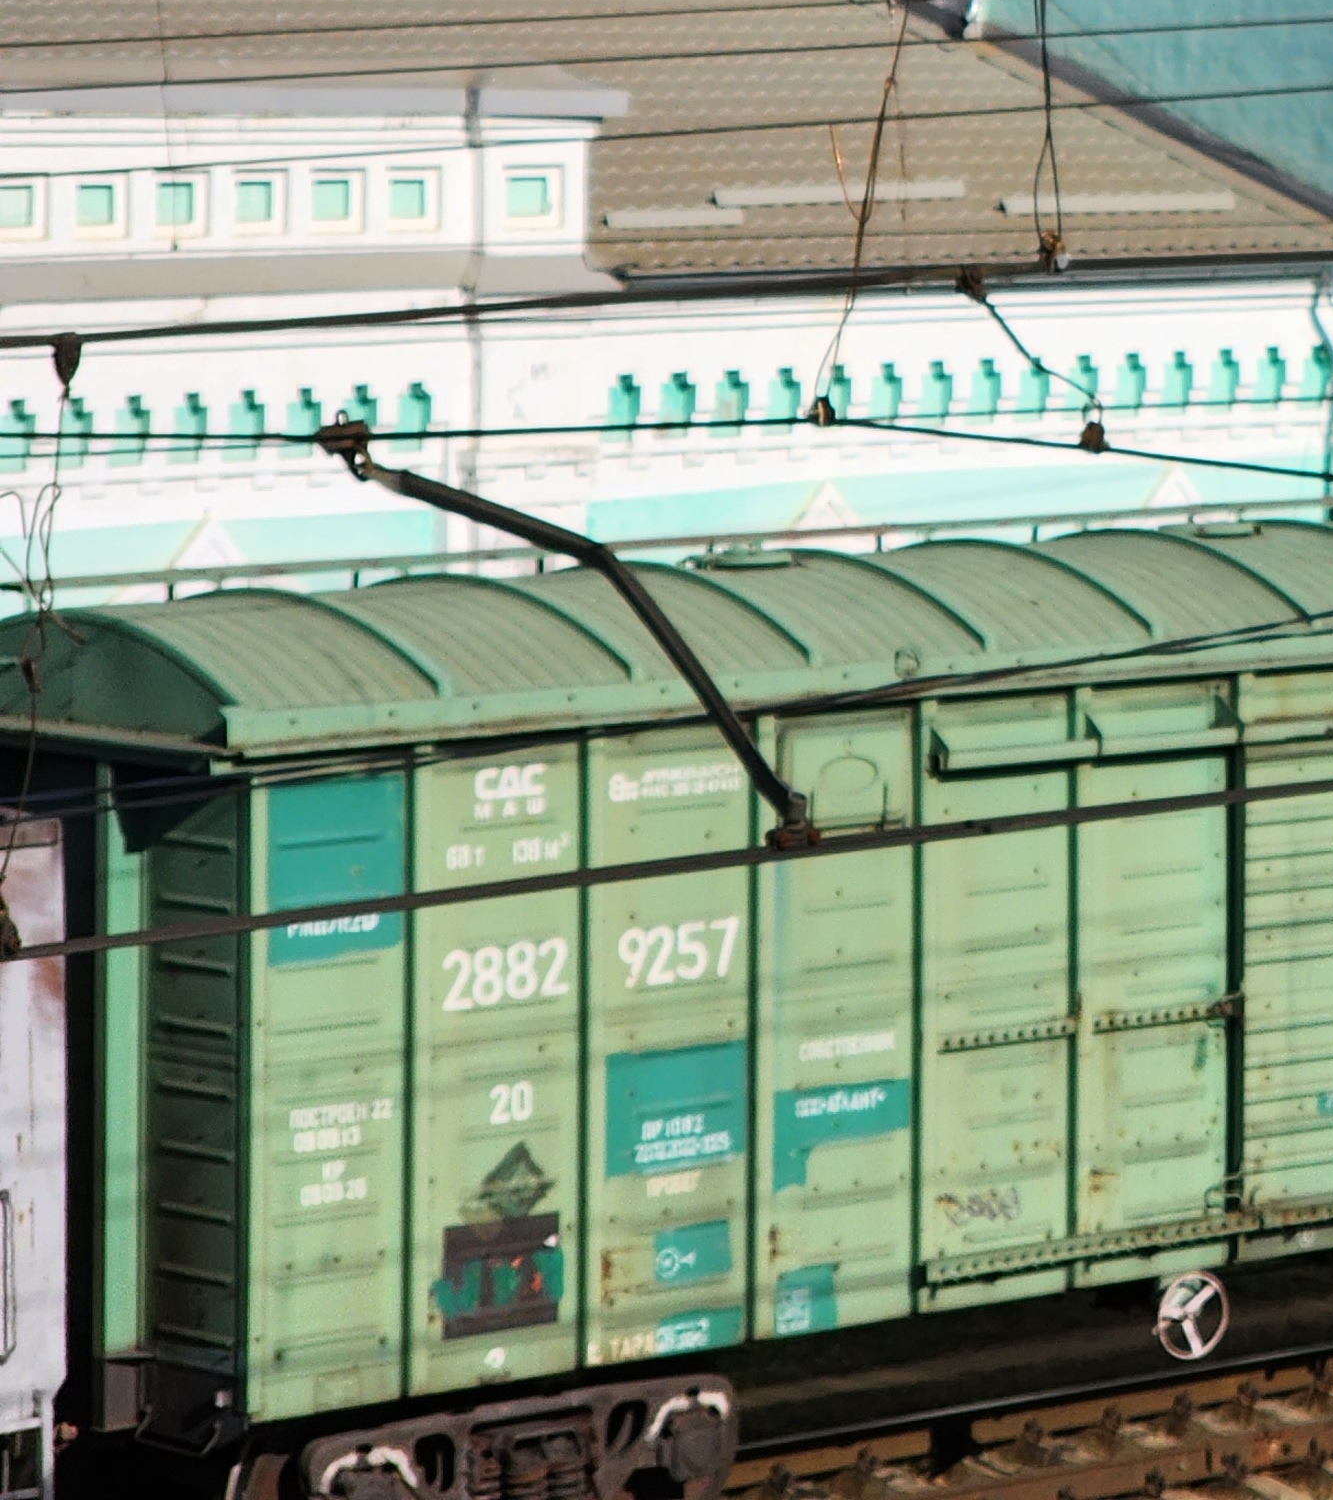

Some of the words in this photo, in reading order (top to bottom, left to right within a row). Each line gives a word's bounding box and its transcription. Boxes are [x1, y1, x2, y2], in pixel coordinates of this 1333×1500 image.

[442, 938, 568, 1012] 2882
[618, 916, 739, 988] 9257
[489, 1081, 533, 1125] 20
